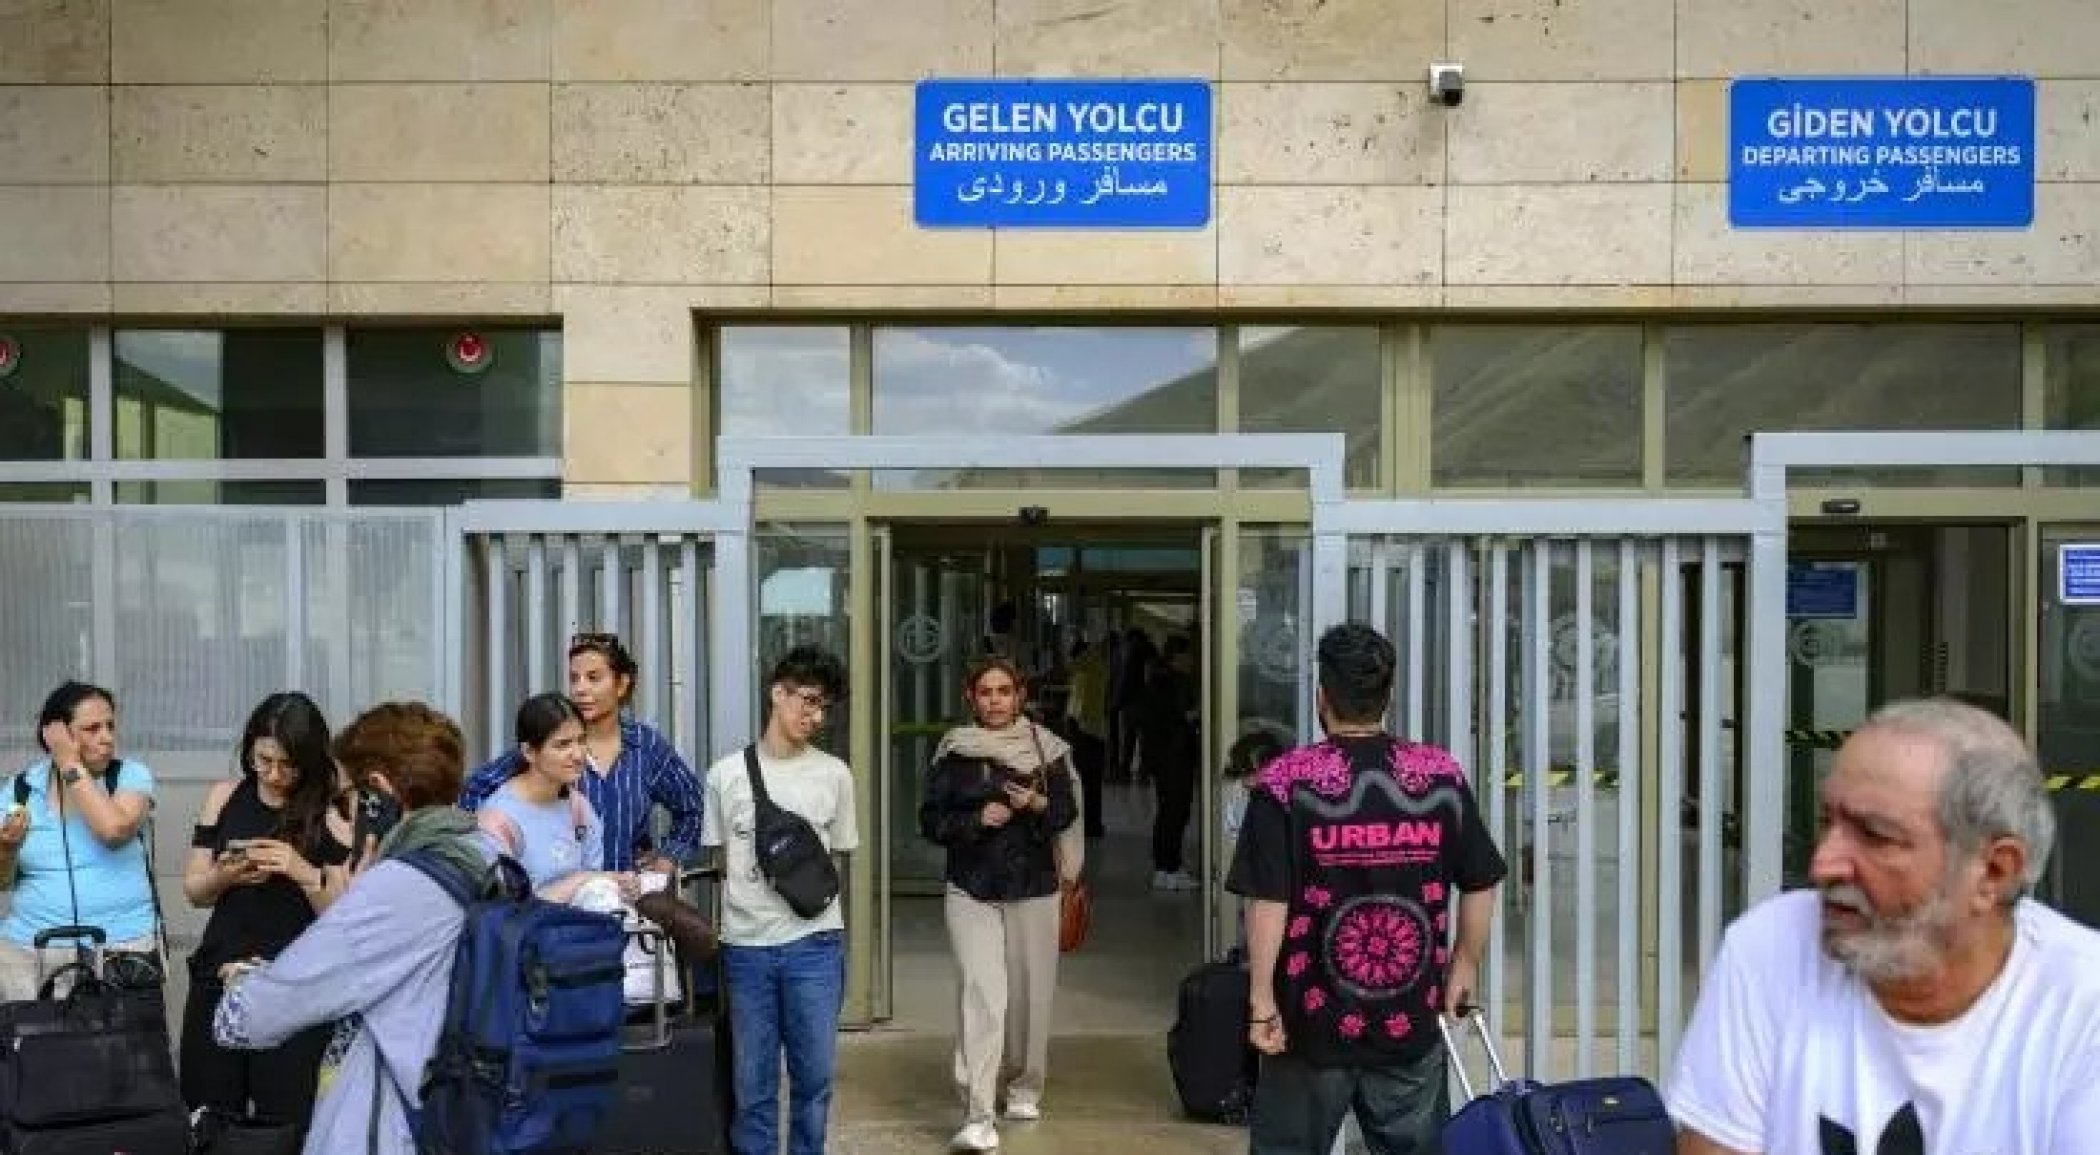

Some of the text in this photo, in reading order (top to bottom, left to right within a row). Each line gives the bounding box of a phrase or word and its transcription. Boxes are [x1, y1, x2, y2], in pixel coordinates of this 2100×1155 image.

[943, 102, 1183, 133] GELEN YOLCU
[1767, 103, 1998, 138] GİDEN YOLCU
[929, 142, 1197, 162] ARRIVING PASSENGERS
[1742, 145, 2021, 165] DEPARTING PASSENGERS
[1080, 166, 1168, 204] مسافر
[1902, 165, 1984, 202] مسافر
[1311, 821, 1441, 849] URBAN
